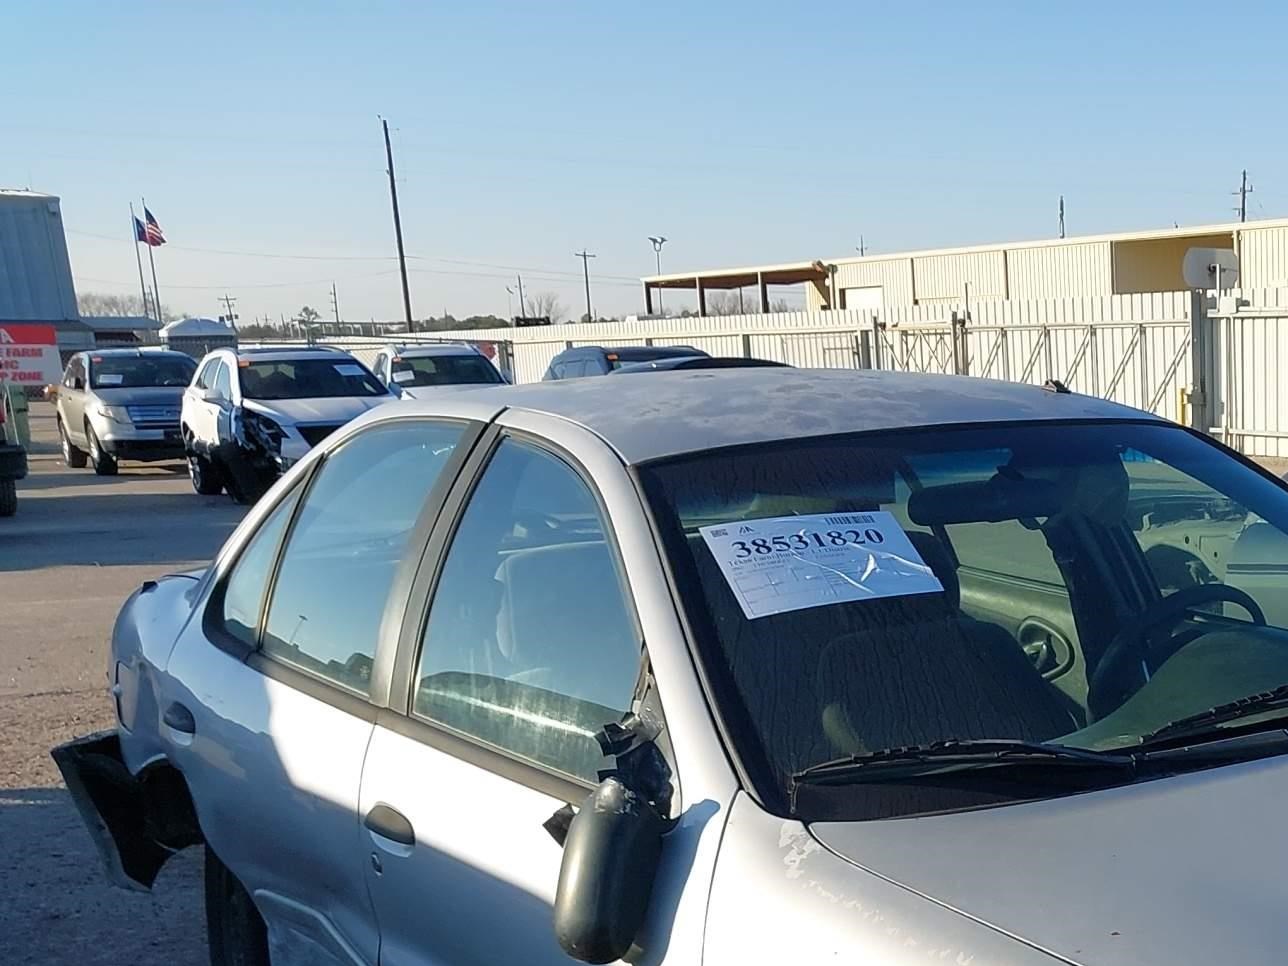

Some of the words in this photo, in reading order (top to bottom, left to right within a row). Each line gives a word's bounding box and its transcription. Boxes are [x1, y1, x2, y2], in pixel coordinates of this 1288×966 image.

[6, 347, 43, 358] FARM
[11, 371, 43, 382] ZONE
[731, 528, 885, 559] 38531820
